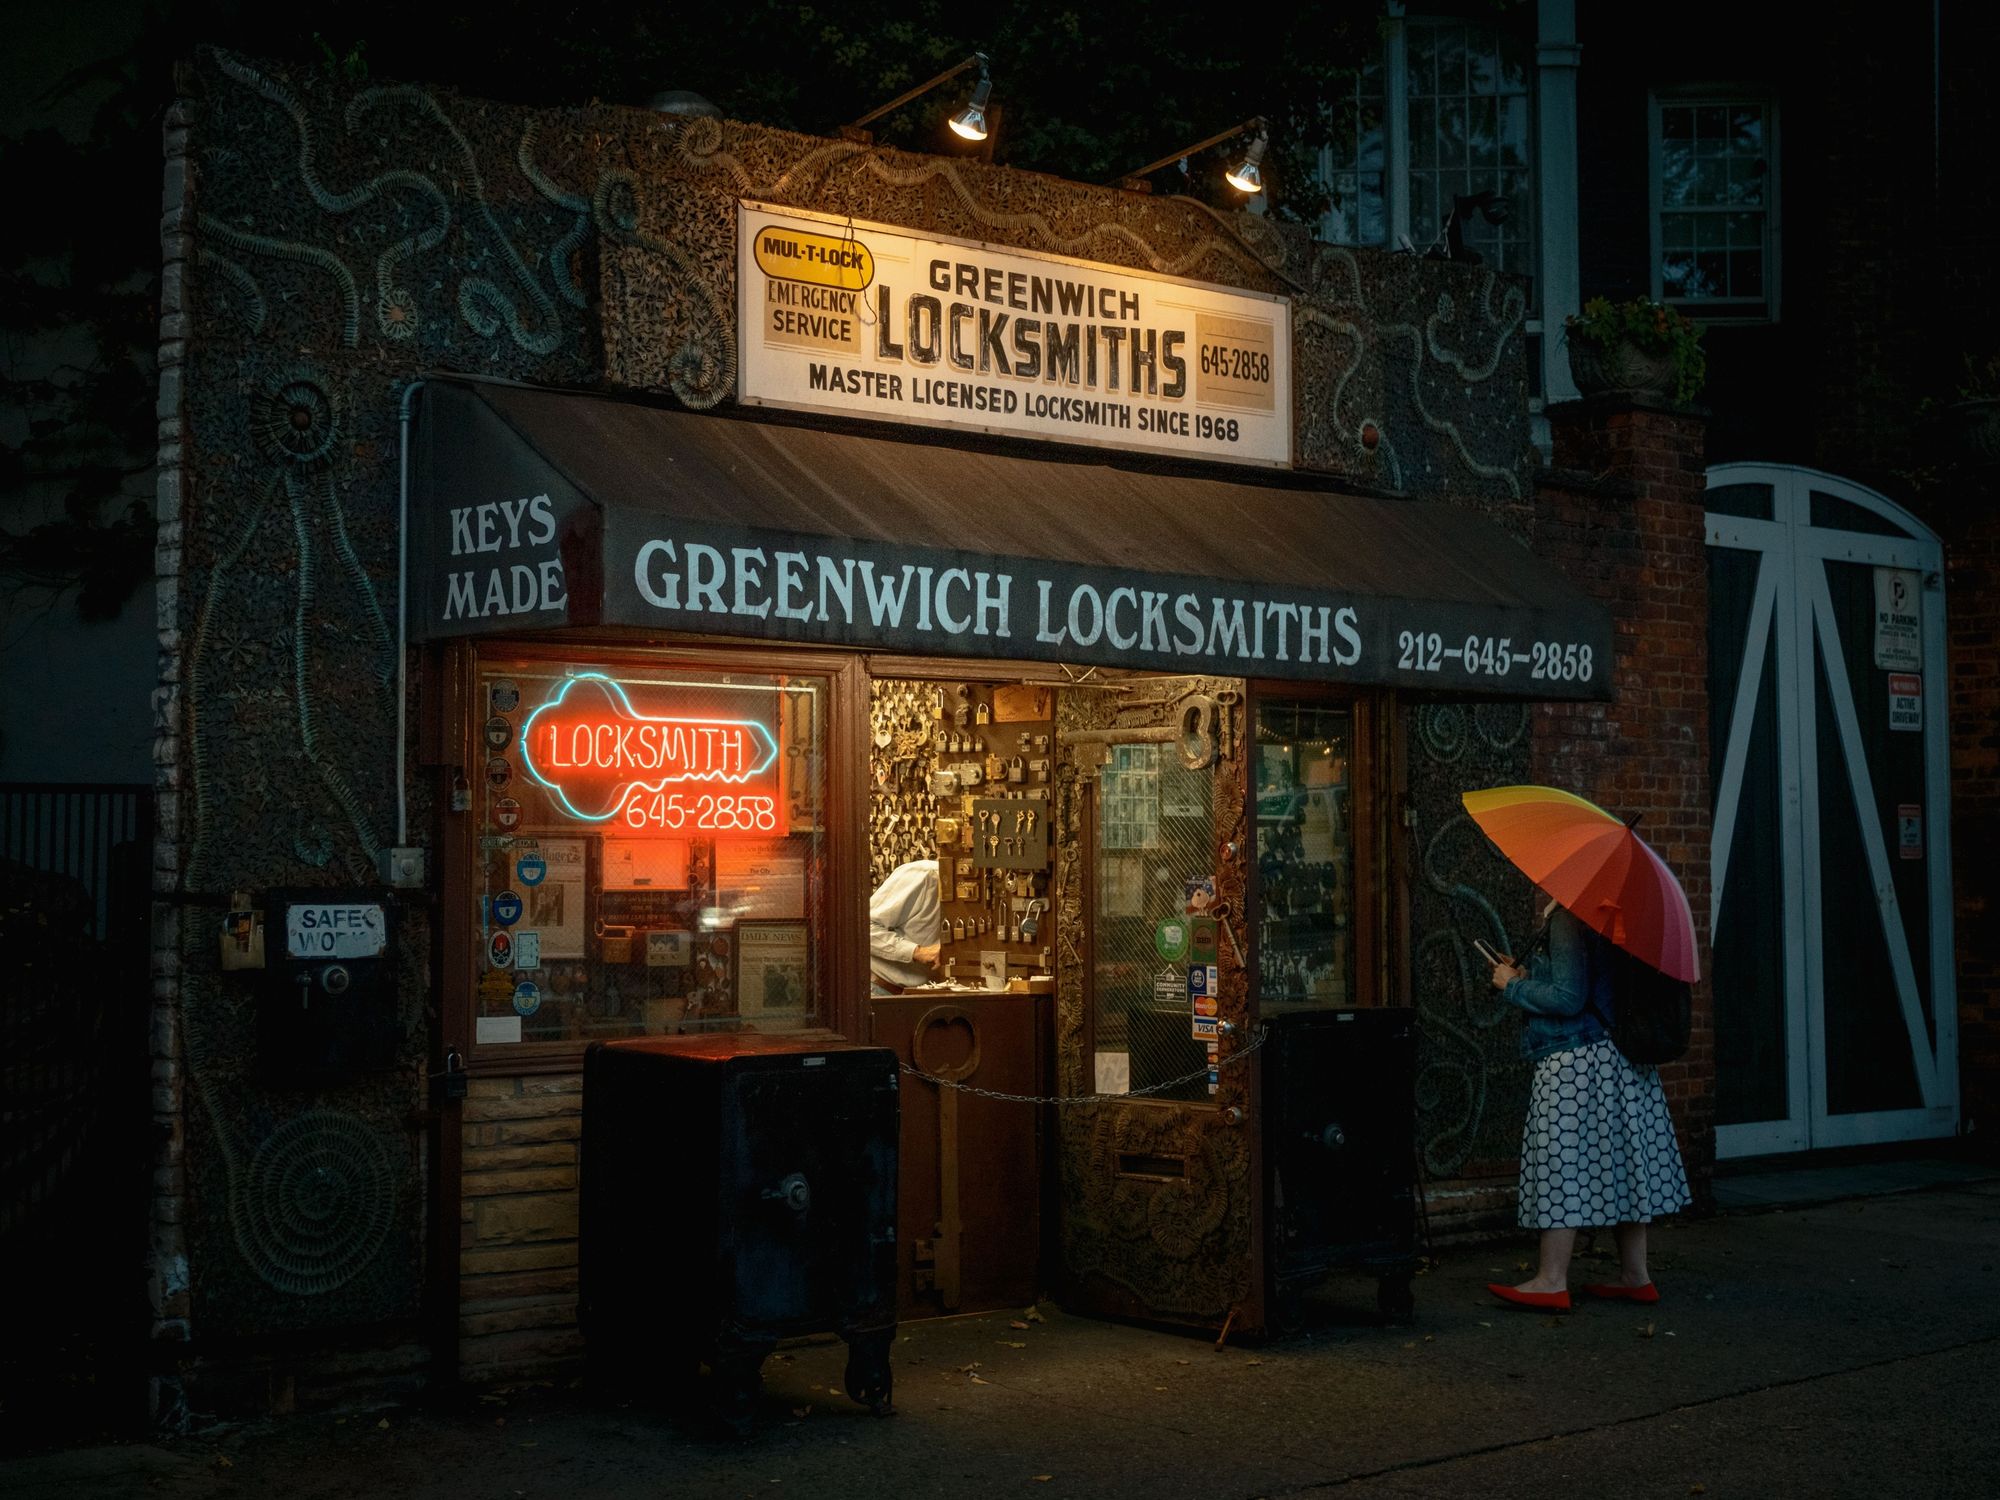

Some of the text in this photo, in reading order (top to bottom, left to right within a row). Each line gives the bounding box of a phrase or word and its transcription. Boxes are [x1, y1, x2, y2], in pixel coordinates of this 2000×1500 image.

[768, 279, 857, 315] EMERGENCY
[929, 259, 1140, 321] GREENWICH
[773, 309, 851, 342] SERVICE
[877, 284, 1187, 399] LOCKSMITHS
[1200, 343, 1269, 383] 645-2858
[809, 363, 1240, 441] MASTER LICENSED LOCKSMITH SINCE 1968
[450, 493, 556, 555] KEYS
[442, 557, 567, 619] MADE
[634, 538, 1593, 683] GREENWICH LOCKSMITHS 212-645-2858
[1879, 612, 1918, 627] NO PARKING
[1893, 711, 1920, 725] DRIVEWAY
[1896, 696, 1915, 710] ACTIVE
[550, 724, 742, 772] LOCKSMITH
[626, 794, 776, 830] 645-2858
[298, 931, 365, 951] WO
[741, 931, 802, 941] DAILY NEWS
[1198, 1024, 1214, 1032] VISA
